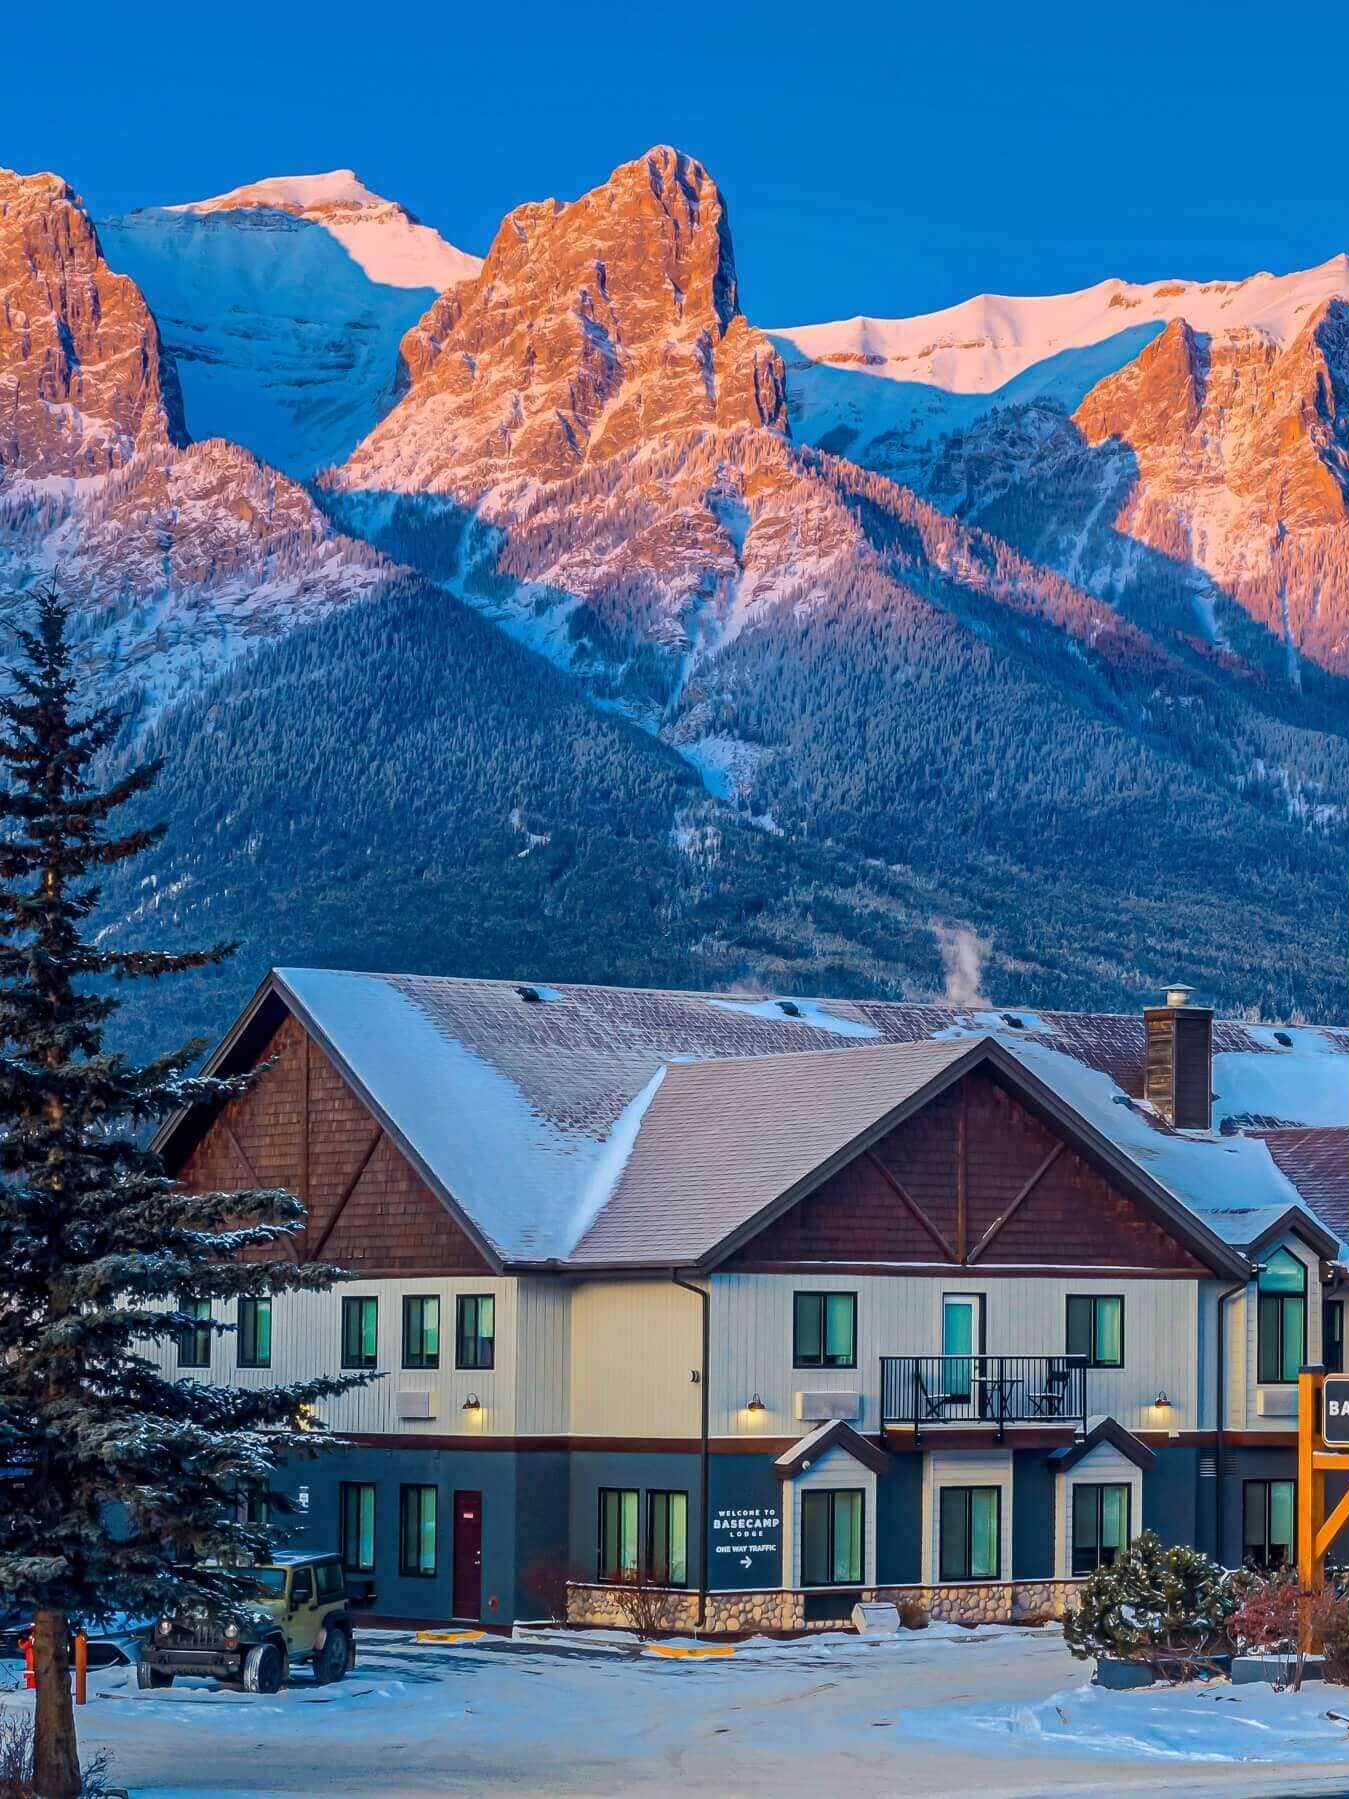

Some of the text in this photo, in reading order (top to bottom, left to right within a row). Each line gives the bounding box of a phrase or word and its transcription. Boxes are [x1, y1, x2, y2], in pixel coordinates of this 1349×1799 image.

[718, 1509, 761, 1517] WELCOME
[713, 1518, 780, 1529] BASECAMP
[729, 1530, 764, 1538] LODGE
[749, 1544, 777, 1552] TRAFFIC
